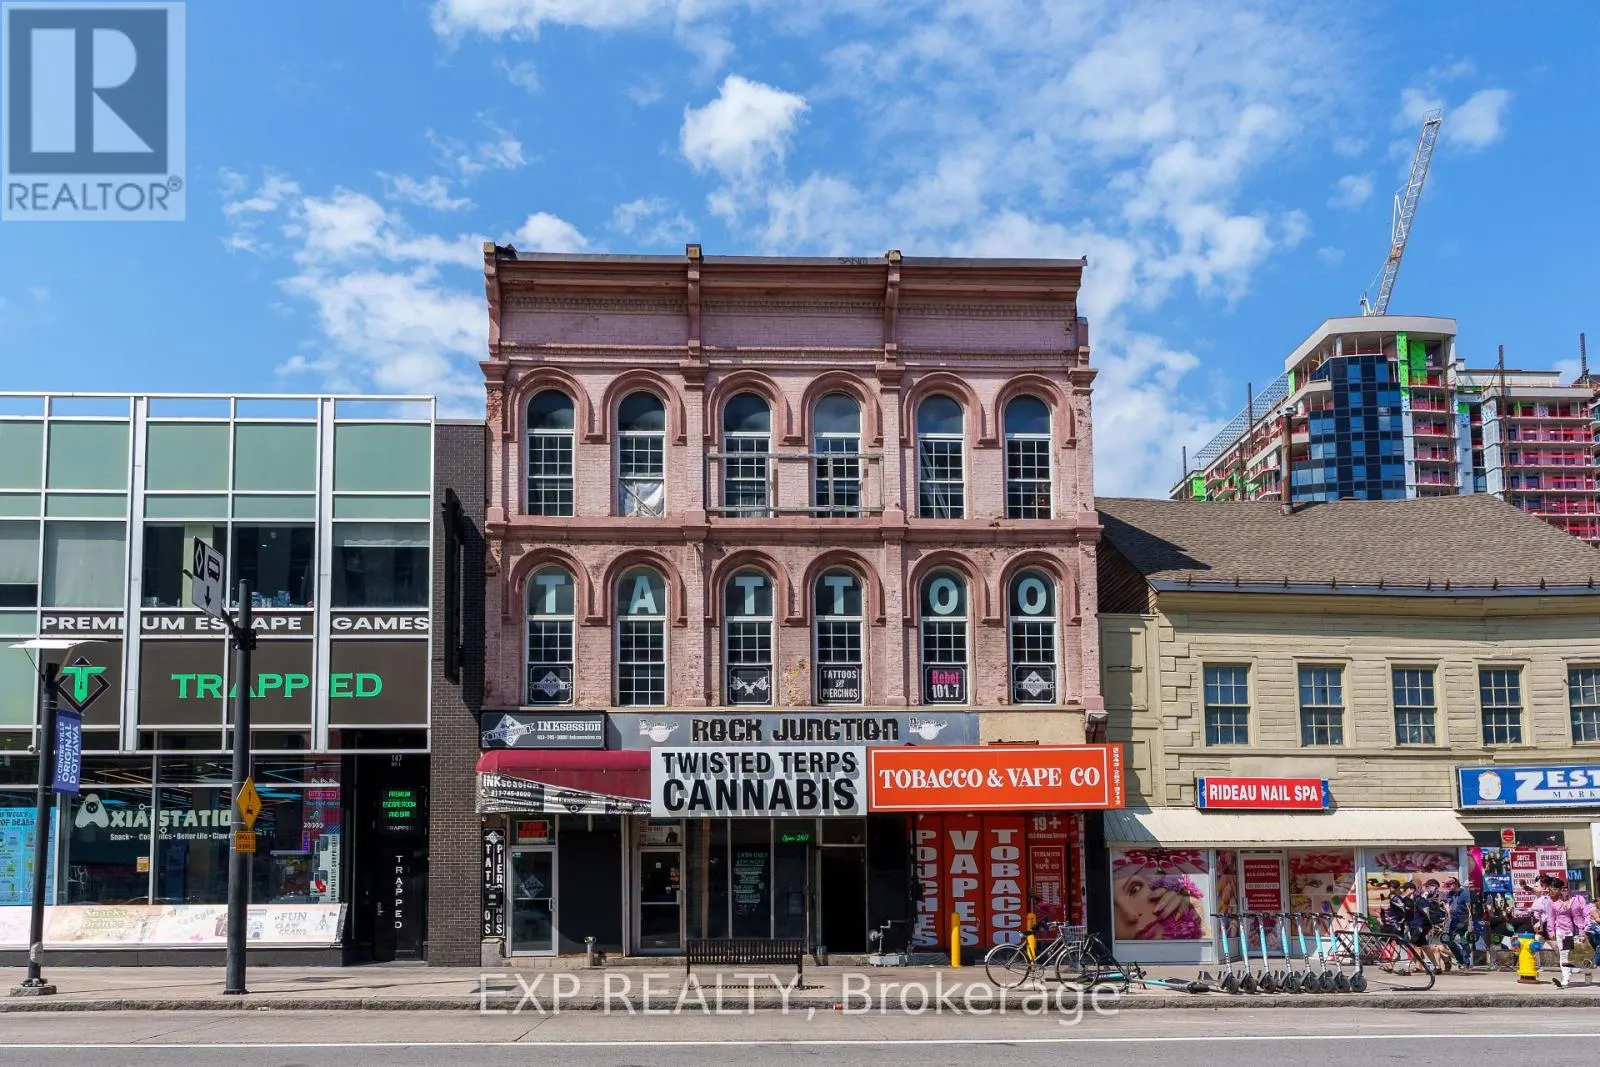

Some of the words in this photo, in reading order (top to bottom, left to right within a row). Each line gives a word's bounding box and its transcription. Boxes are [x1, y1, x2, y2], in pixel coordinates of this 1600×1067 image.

[41, 616, 185, 630] PREMIUM
[195, 617, 302, 630] ESAPE
[332, 617, 430, 630] GAMES
[823, 670, 857, 679] TATTOOS
[932, 670, 960, 684] Rebel
[823, 688, 858, 698] PIERCINGS
[932, 684, 960, 698] 101.7
[537, 720, 601, 731] INKsession
[690, 718, 762, 742] ROCK
[62, 723, 72, 782] ORIGINAL
[69, 725, 79, 784] D'OTTAWA
[661, 752, 773, 774] TWISTED
[786, 751, 857, 774] TERPS
[879, 768, 983, 789] TOBACCO
[986, 768, 1004, 788] &
[1005, 767, 1062, 788] VAPE
[1069, 766, 1100, 786] CO
[662, 778, 856, 811] CANNABIS
[1209, 784, 1257, 801] RIDEAU
[1260, 784, 1291, 801] NAIL
[1294, 785, 1318, 802] SPA
[159, 809, 231, 827] STATIO
[110, 833, 130, 841] Snack
[394, 855, 403, 929] TRAPPED
[484, 844, 492, 934] TATOS
[949, 830, 979, 946] VAPES
[990, 829, 1022, 946] TOBACCO
[280, 911, 308, 921] FUN
